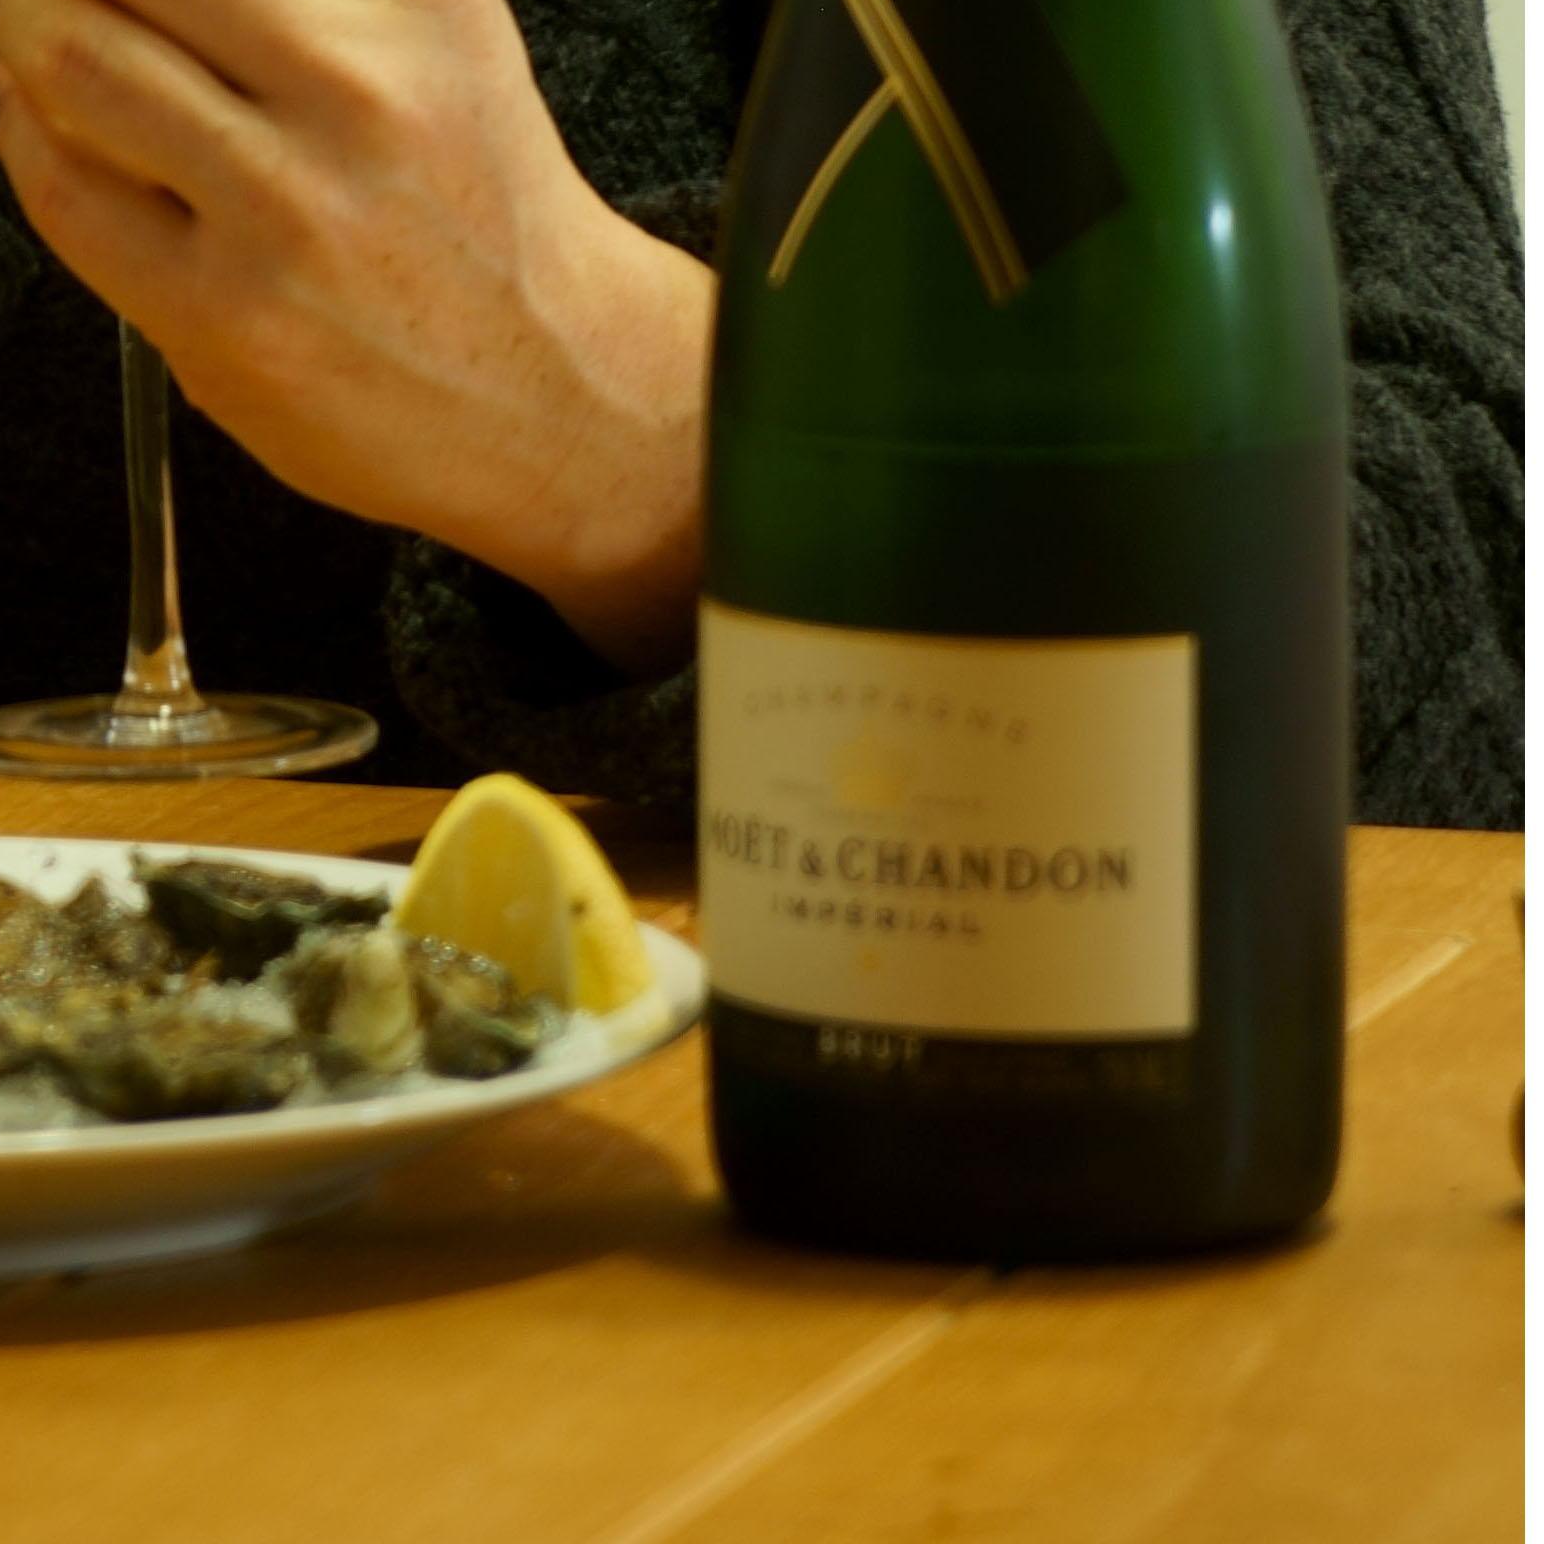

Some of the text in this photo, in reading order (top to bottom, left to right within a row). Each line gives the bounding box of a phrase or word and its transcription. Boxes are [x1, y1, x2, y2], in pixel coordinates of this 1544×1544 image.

[798, 837, 825, 879] &
[835, 834, 1133, 895] CHANDON
[817, 1025, 922, 1062] BRUT
